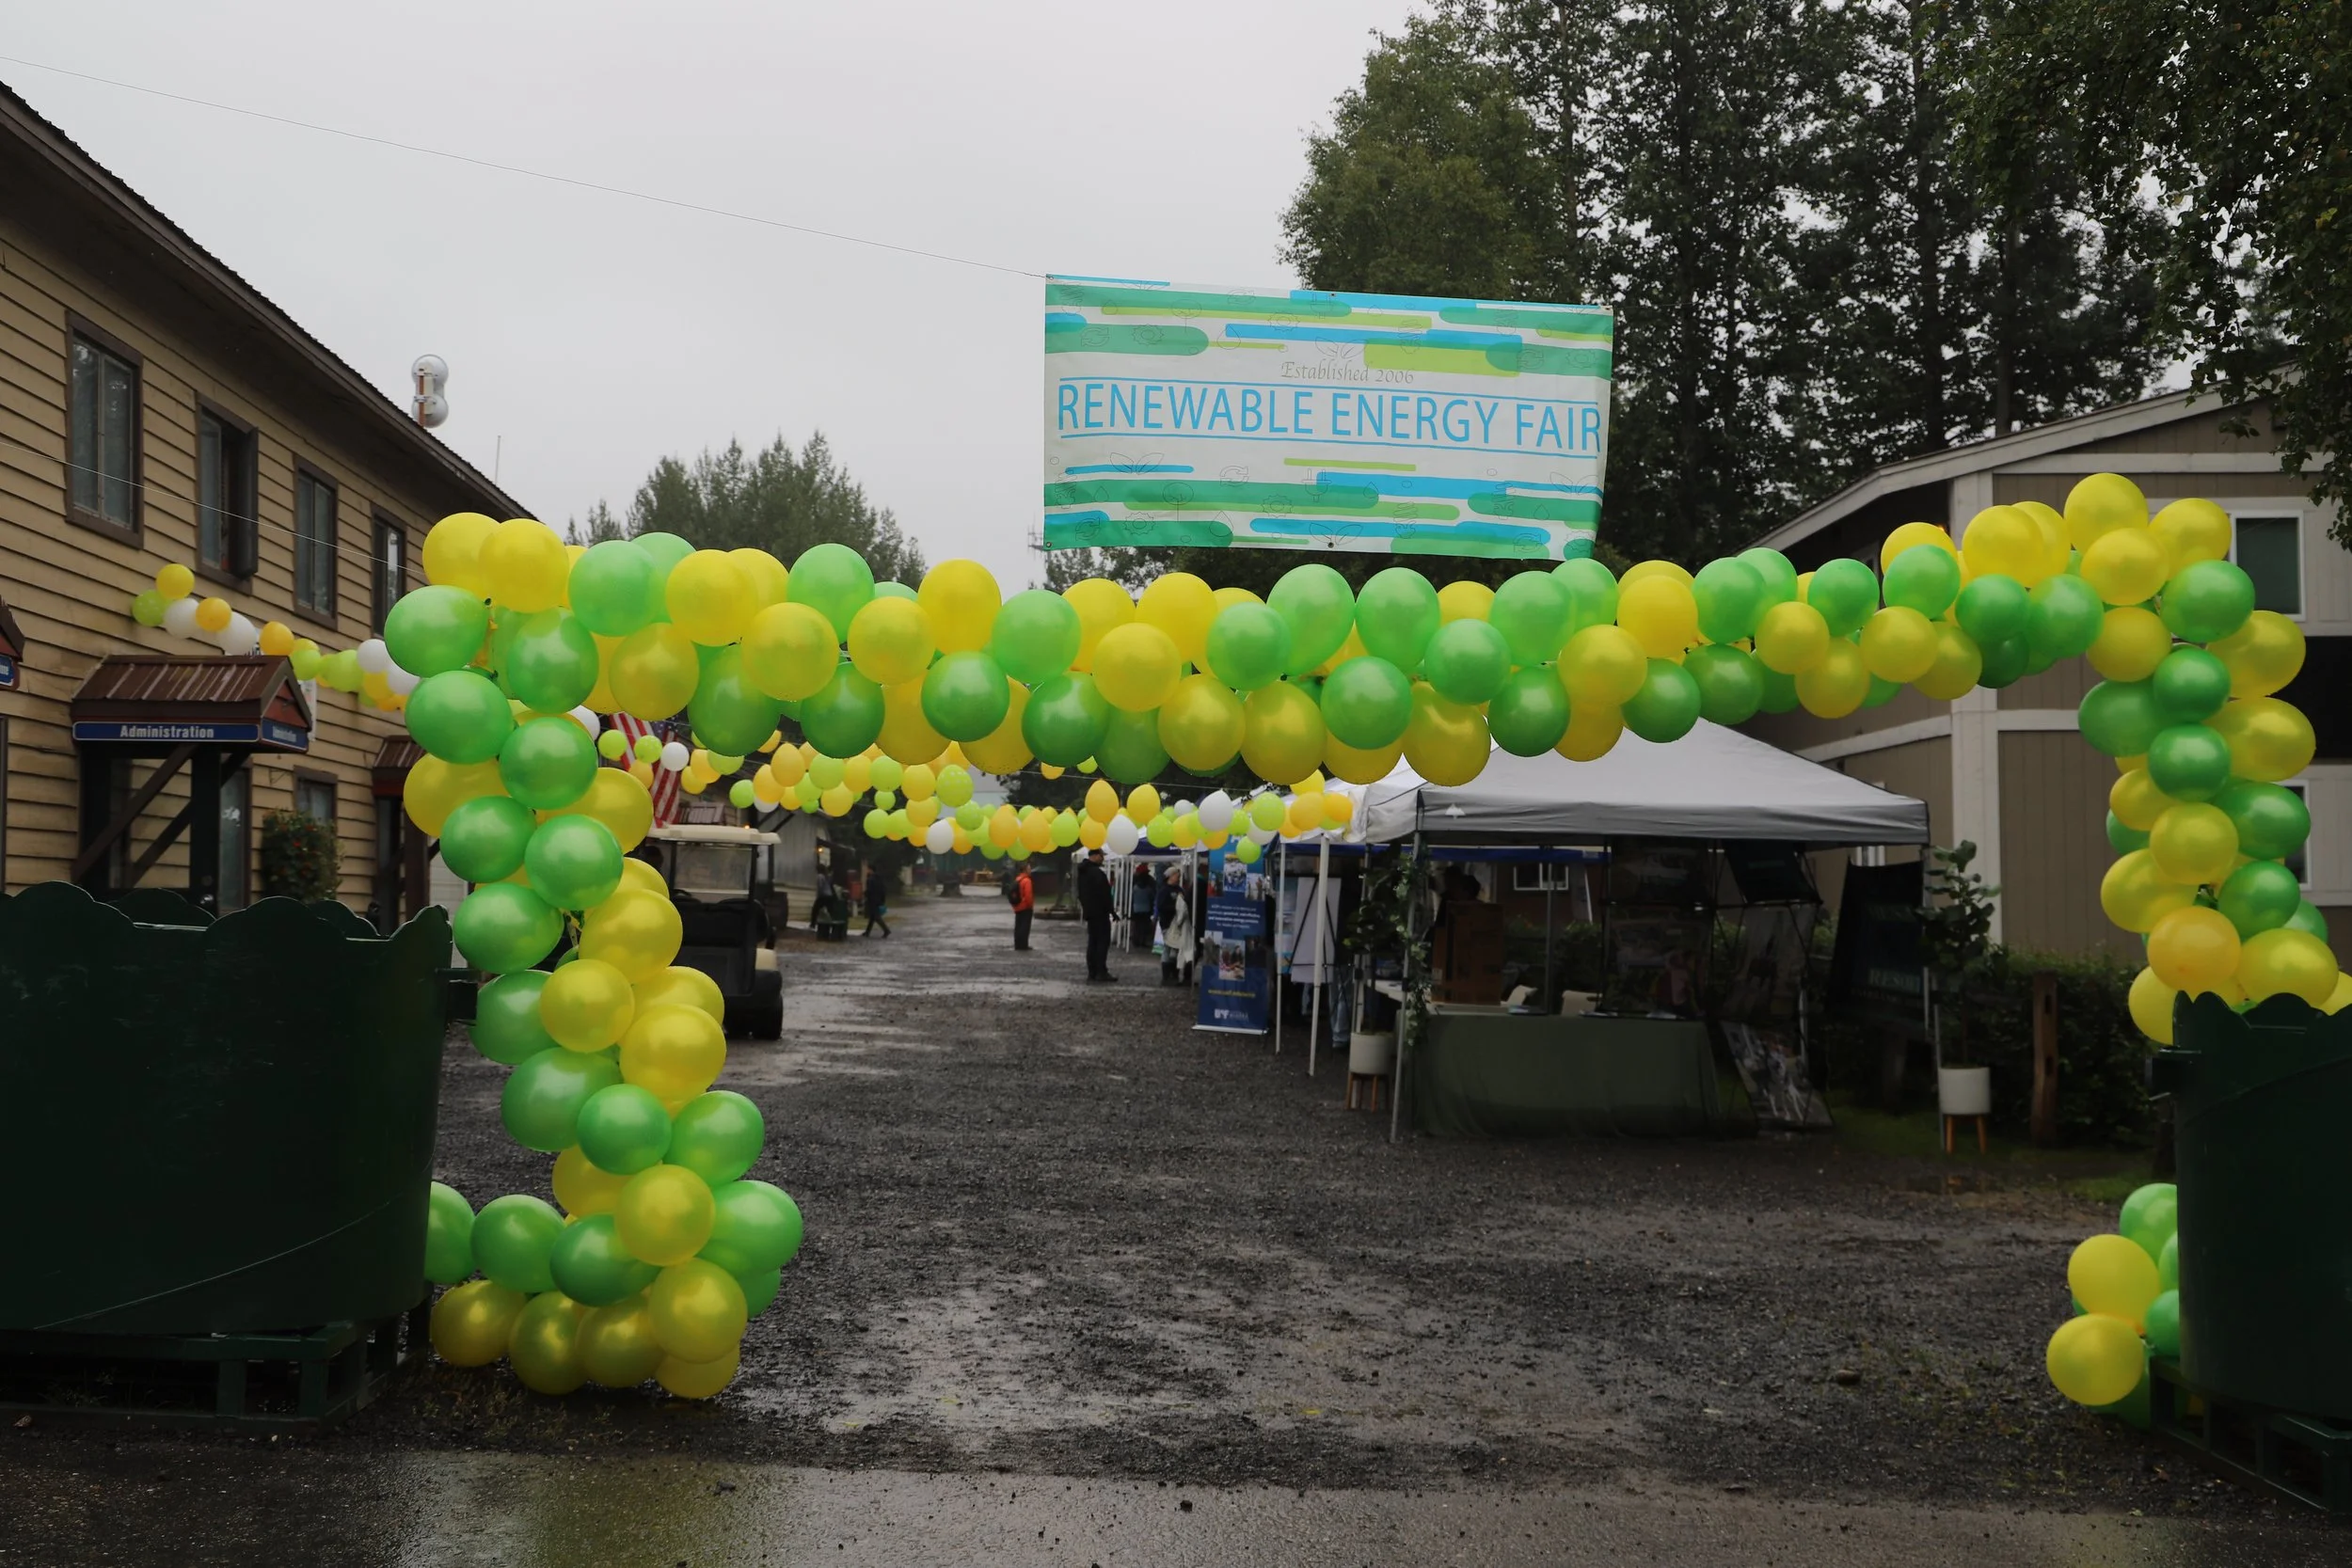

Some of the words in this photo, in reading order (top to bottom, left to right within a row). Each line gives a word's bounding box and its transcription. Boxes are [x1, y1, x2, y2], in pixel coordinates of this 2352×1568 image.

[1281, 358, 1369, 382] Established
[1375, 368, 1414, 384] 2006
[1058, 384, 1313, 434] RENEWABLE
[1332, 392, 1499, 444] ENERGY
[1516, 404, 1600, 452] FAIR
[119, 724, 215, 738] Administration
